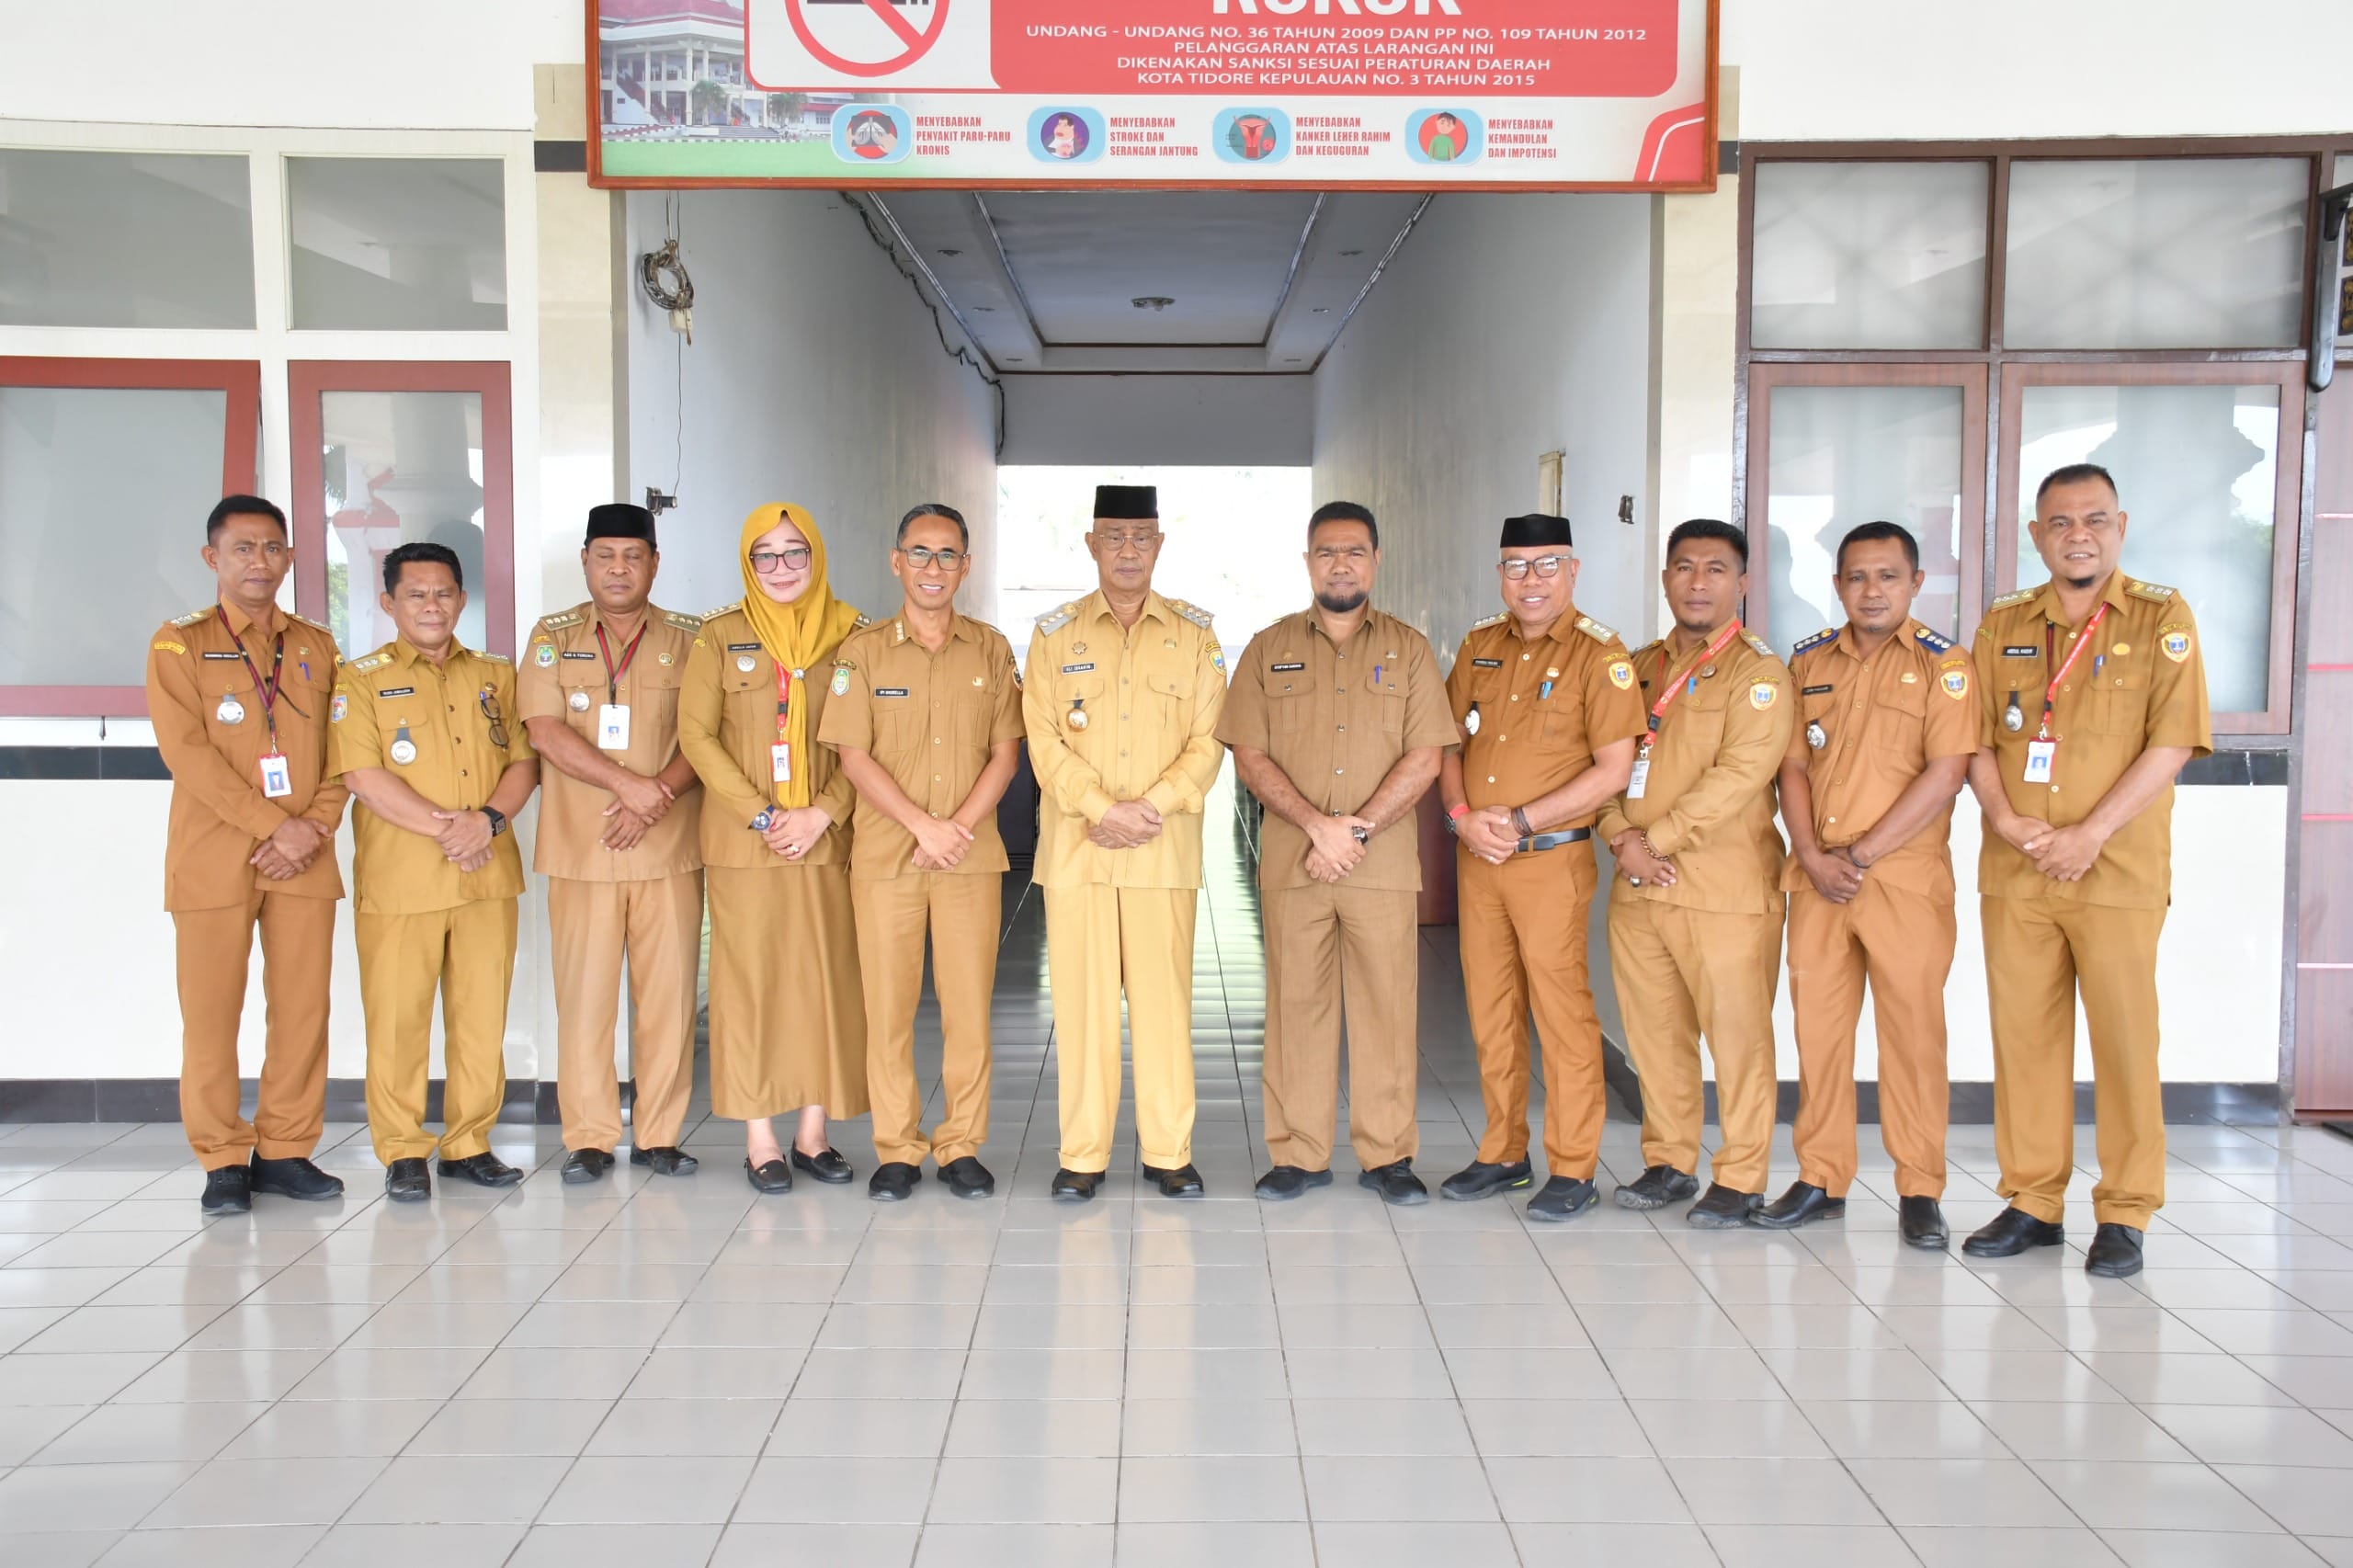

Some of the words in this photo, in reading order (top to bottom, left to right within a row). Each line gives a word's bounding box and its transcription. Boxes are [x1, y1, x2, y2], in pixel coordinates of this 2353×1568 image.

[1027, 26, 1107, 37] UNDANG
[1125, 26, 1204, 37] UNDANG
[1211, 27, 1242, 38] NO.
[1248, 28, 1267, 38] 36
[1273, 28, 1336, 38] TAHUN
[1342, 28, 1384, 39] 2009
[1391, 28, 1429, 39] DAN
[1436, 28, 1456, 39] PP
[1463, 28, 1494, 39] NO.
[1501, 28, 1530, 40] 109
[1535, 29, 1597, 40] TAHUN
[1604, 29, 1645, 40] 2012
[1175, 42, 1310, 53] PELANGGARAN
[1316, 43, 1358, 53] ATAS
[1365, 44, 1463, 54] LARANGAN
[1471, 44, 1494, 54] INI
[1118, 57, 1222, 68] DIKENAKAN
[1229, 58, 1291, 69] SANKSI
[1299, 59, 1359, 69] SESUAI
[1366, 59, 1471, 69] PERATURAN
[1477, 59, 1550, 70] DAERAH
[1138, 73, 1184, 84] KOTA
[1188, 74, 1253, 84] TIDORE
[1260, 74, 1367, 85] KEPULAUAN
[1373, 74, 1404, 85] NO.
[1410, 74, 1419, 85] 3
[1425, 74, 1486, 85] TAHUN
[1493, 74, 1535, 85] 2015
[916, 117, 982, 126] MENYEBABKAN
[1110, 118, 1176, 127] MENYEBABKAN
[1296, 117, 1361, 127] MENYEBABKAN
[1488, 119, 1553, 129] MENYEBABKAN
[916, 131, 958, 141] PENYAKIT
[961, 132, 1011, 142] PARU-PARU
[1110, 132, 1144, 142] STROKE
[1146, 132, 1165, 142] DAN
[1296, 132, 1331, 142] KANKER
[1333, 132, 1360, 142] LEHER
[1361, 132, 1391, 142] RAHIM
[1488, 134, 1549, 143] KEMANDULAN
[916, 145, 950, 154] KRONIS
[1110, 146, 1157, 155] SERANGAN
[1159, 146, 1199, 156] JANTUNG
[1296, 146, 1314, 155] DAN
[1488, 148, 1506, 157] DAN
[1508, 148, 1557, 158] IMPOTENSI
